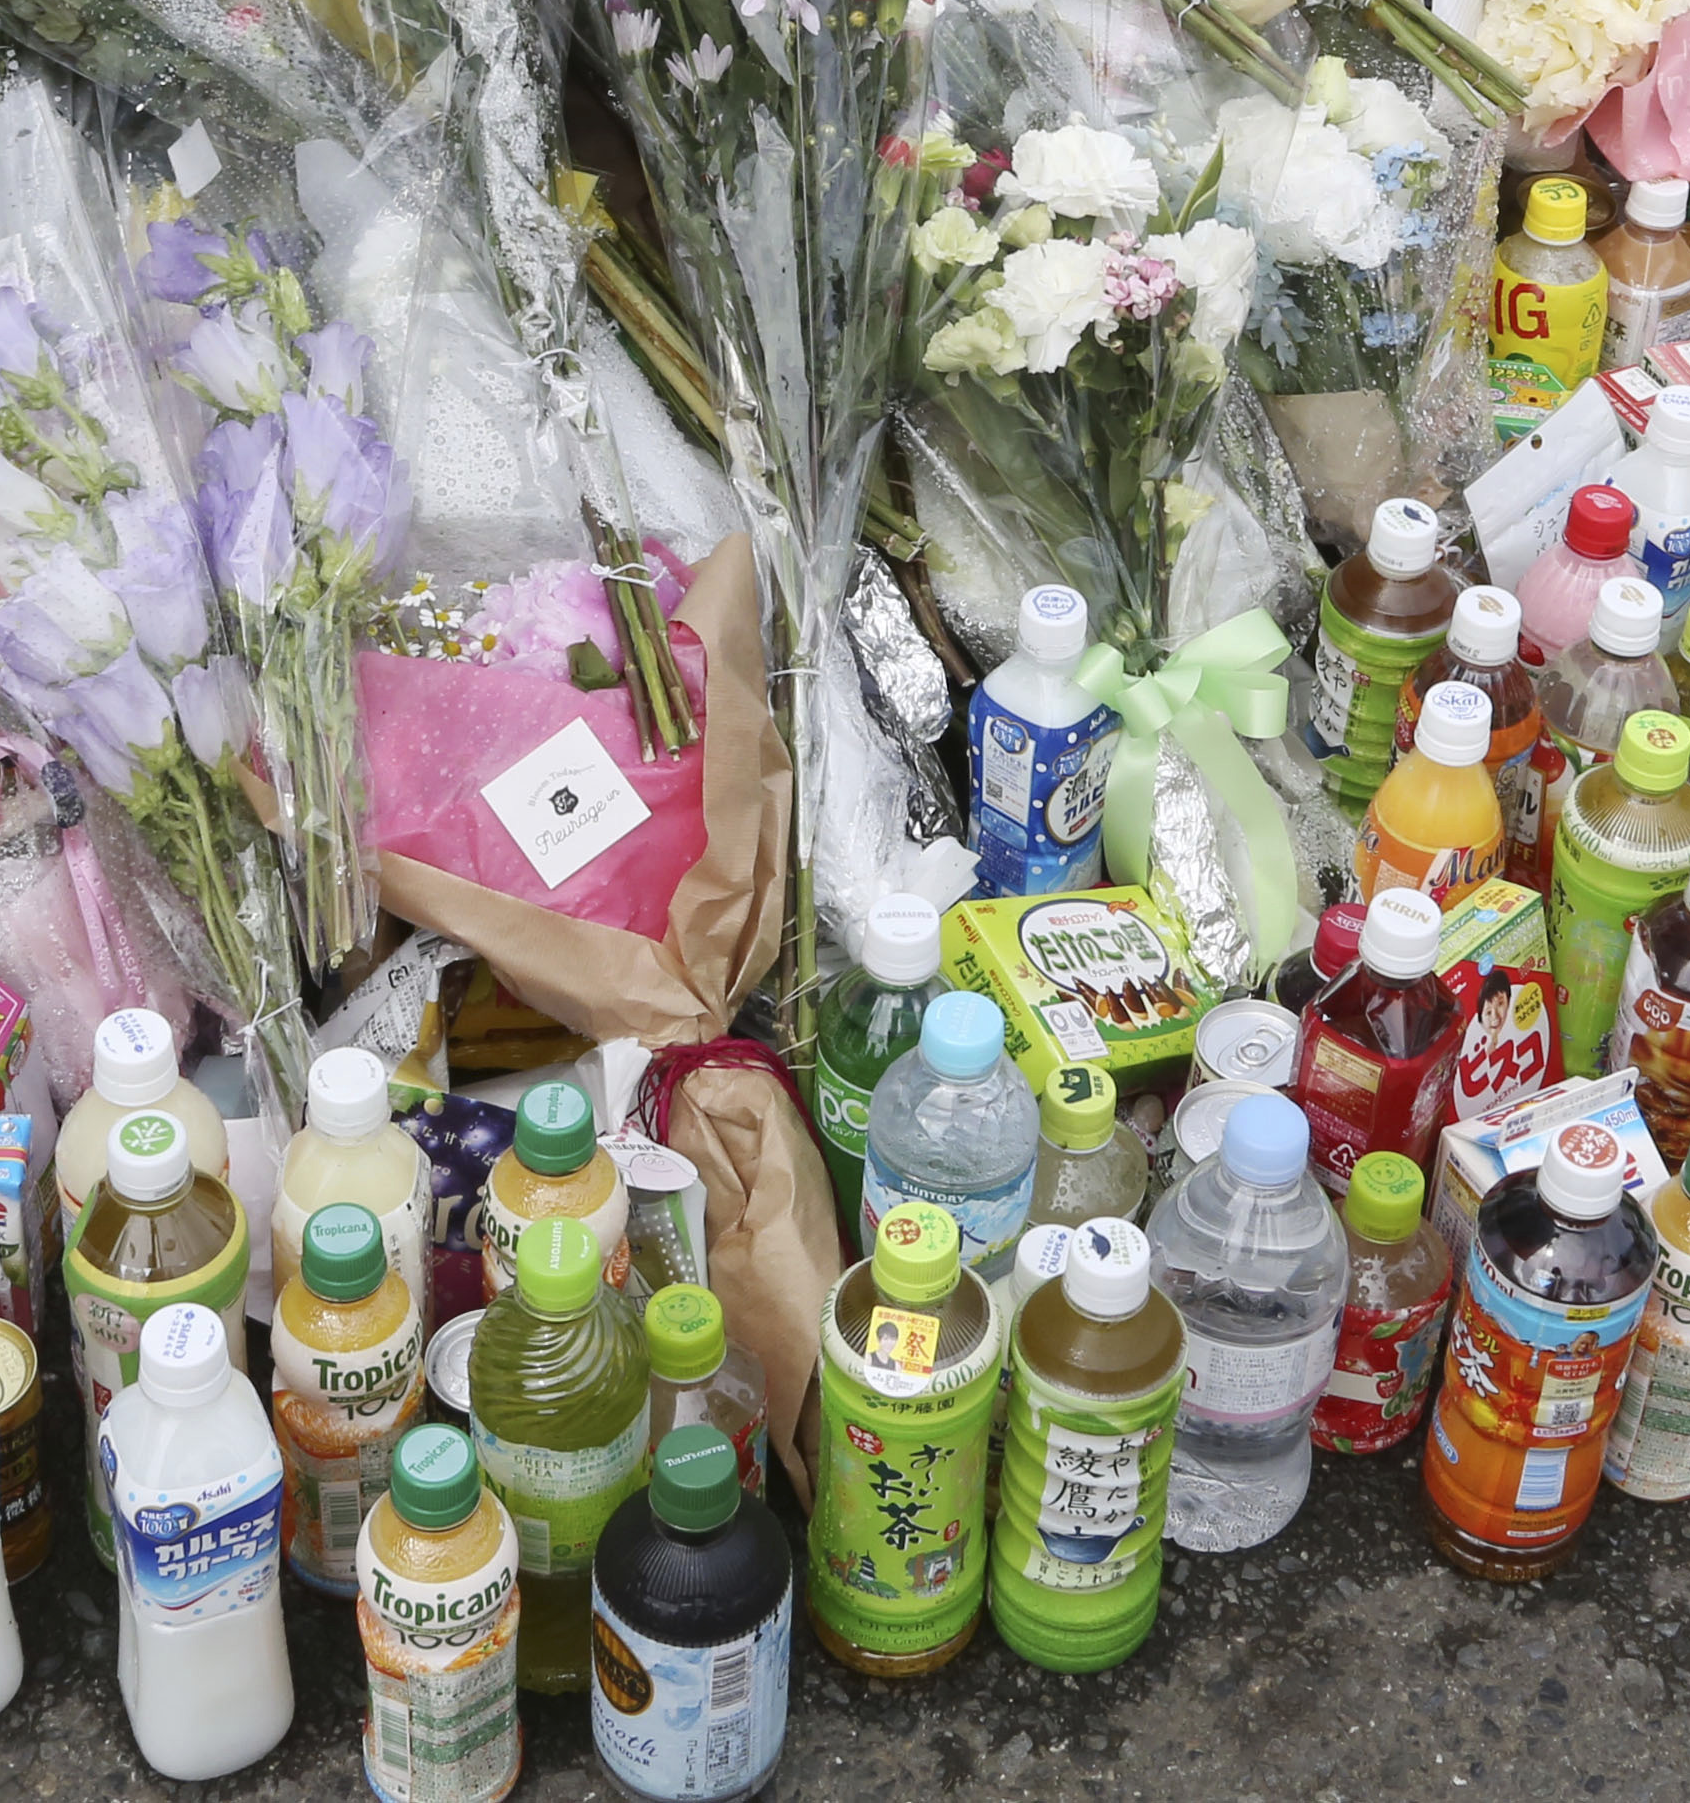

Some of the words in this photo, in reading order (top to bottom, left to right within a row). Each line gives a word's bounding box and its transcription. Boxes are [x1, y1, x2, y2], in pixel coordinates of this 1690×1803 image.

[1380, 897, 1432, 925] KIRIN
[956, 912, 982, 945] meiji
[1028, 918, 1161, 973] たけのこの里
[1641, 997, 1672, 1026] 600
[1644, 1015, 1662, 1031] ml
[113, 1014, 140, 1047] CALPIS
[1458, 1029, 1547, 1097] ビスコ
[1602, 1107, 1639, 1130] 450ml
[607, 1140, 661, 1154] RBAPAPA
[901, 1179, 967, 1205] SUNTORY
[312, 1222, 371, 1238] Tropicana
[547, 1219, 565, 1270] SUNTORY
[1045, 1240, 1066, 1275] CALPIS
[171, 1318, 195, 1361] CALPIS
[903, 1330, 931, 1362] 祭
[930, 1358, 988, 1395] 600ml
[889, 1397, 956, 1414] 伊藤園
[408, 1434, 462, 1476] Tropicana
[515, 1455, 565, 1473] GREEN
[692, 1443, 729, 1463] COFFEE
[524, 1467, 555, 1479] TEA
[1047, 1446, 1107, 1519] 綾鷹
[1105, 1437, 1137, 1525] あやたか
[196, 1482, 232, 1505] Asahi
[866, 1460, 939, 1552] お茶
[153, 1507, 278, 1564] カルピス
[157, 1533, 276, 1584] ウォーター
[371, 1565, 514, 1626] Tropicana
[395, 1620, 498, 1652] 100%
[887, 1617, 938, 1636] Ocha
